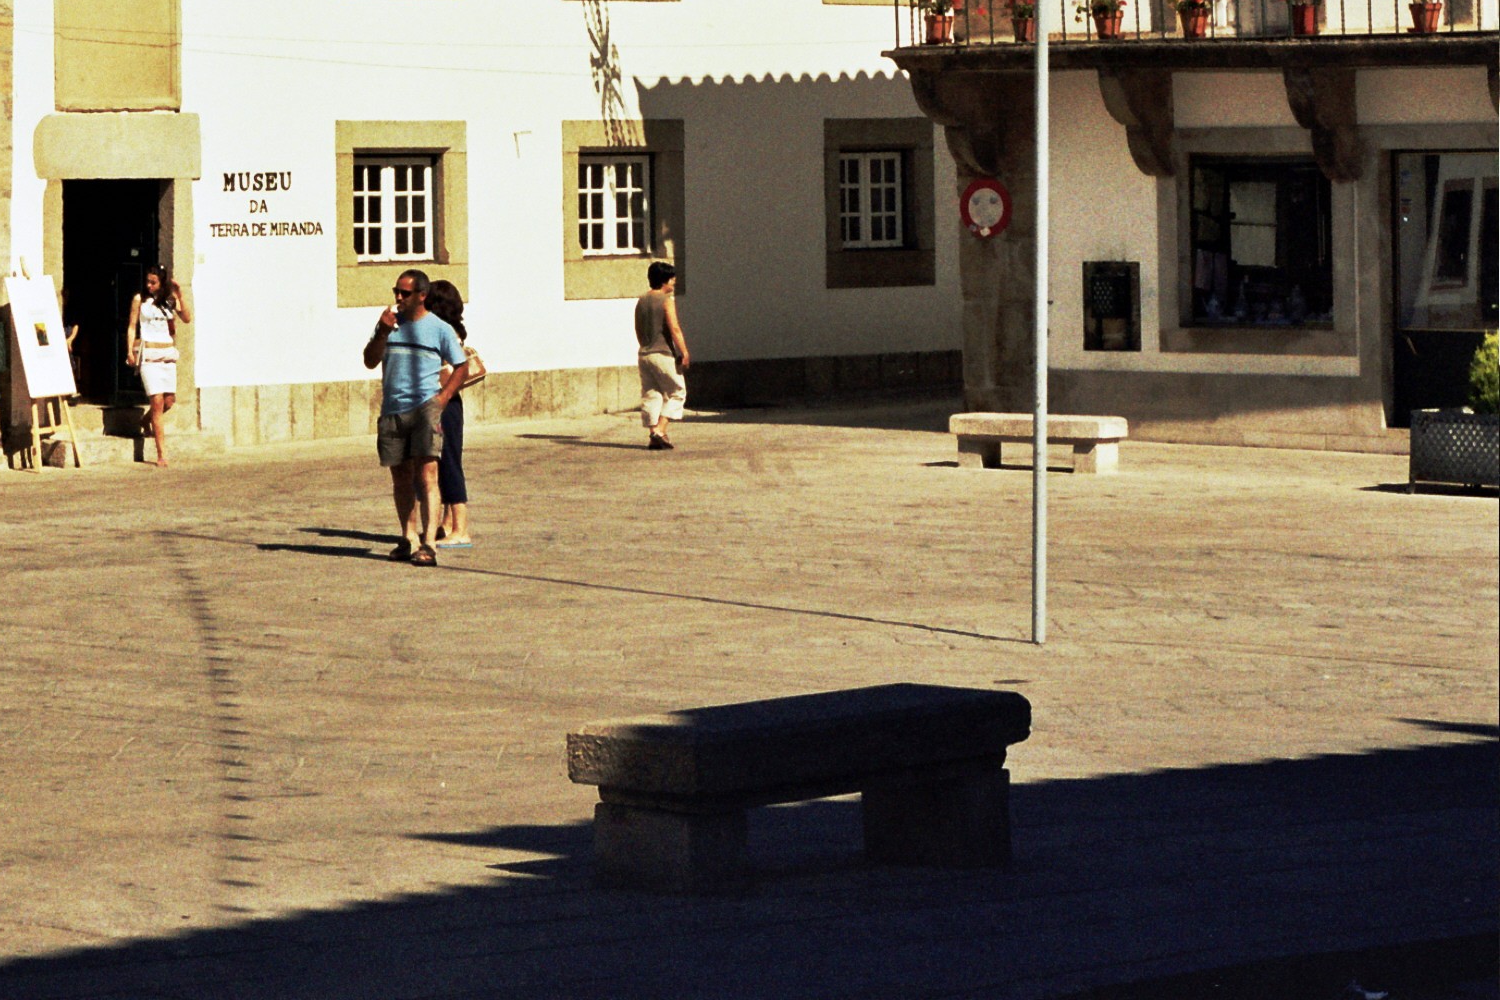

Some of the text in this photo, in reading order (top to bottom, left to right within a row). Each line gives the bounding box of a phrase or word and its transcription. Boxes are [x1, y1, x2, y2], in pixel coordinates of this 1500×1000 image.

[223, 171, 291, 192] MUSEU
[249, 199, 268, 214] DA
[209, 221, 324, 237] TERRA DE MIRANDA
